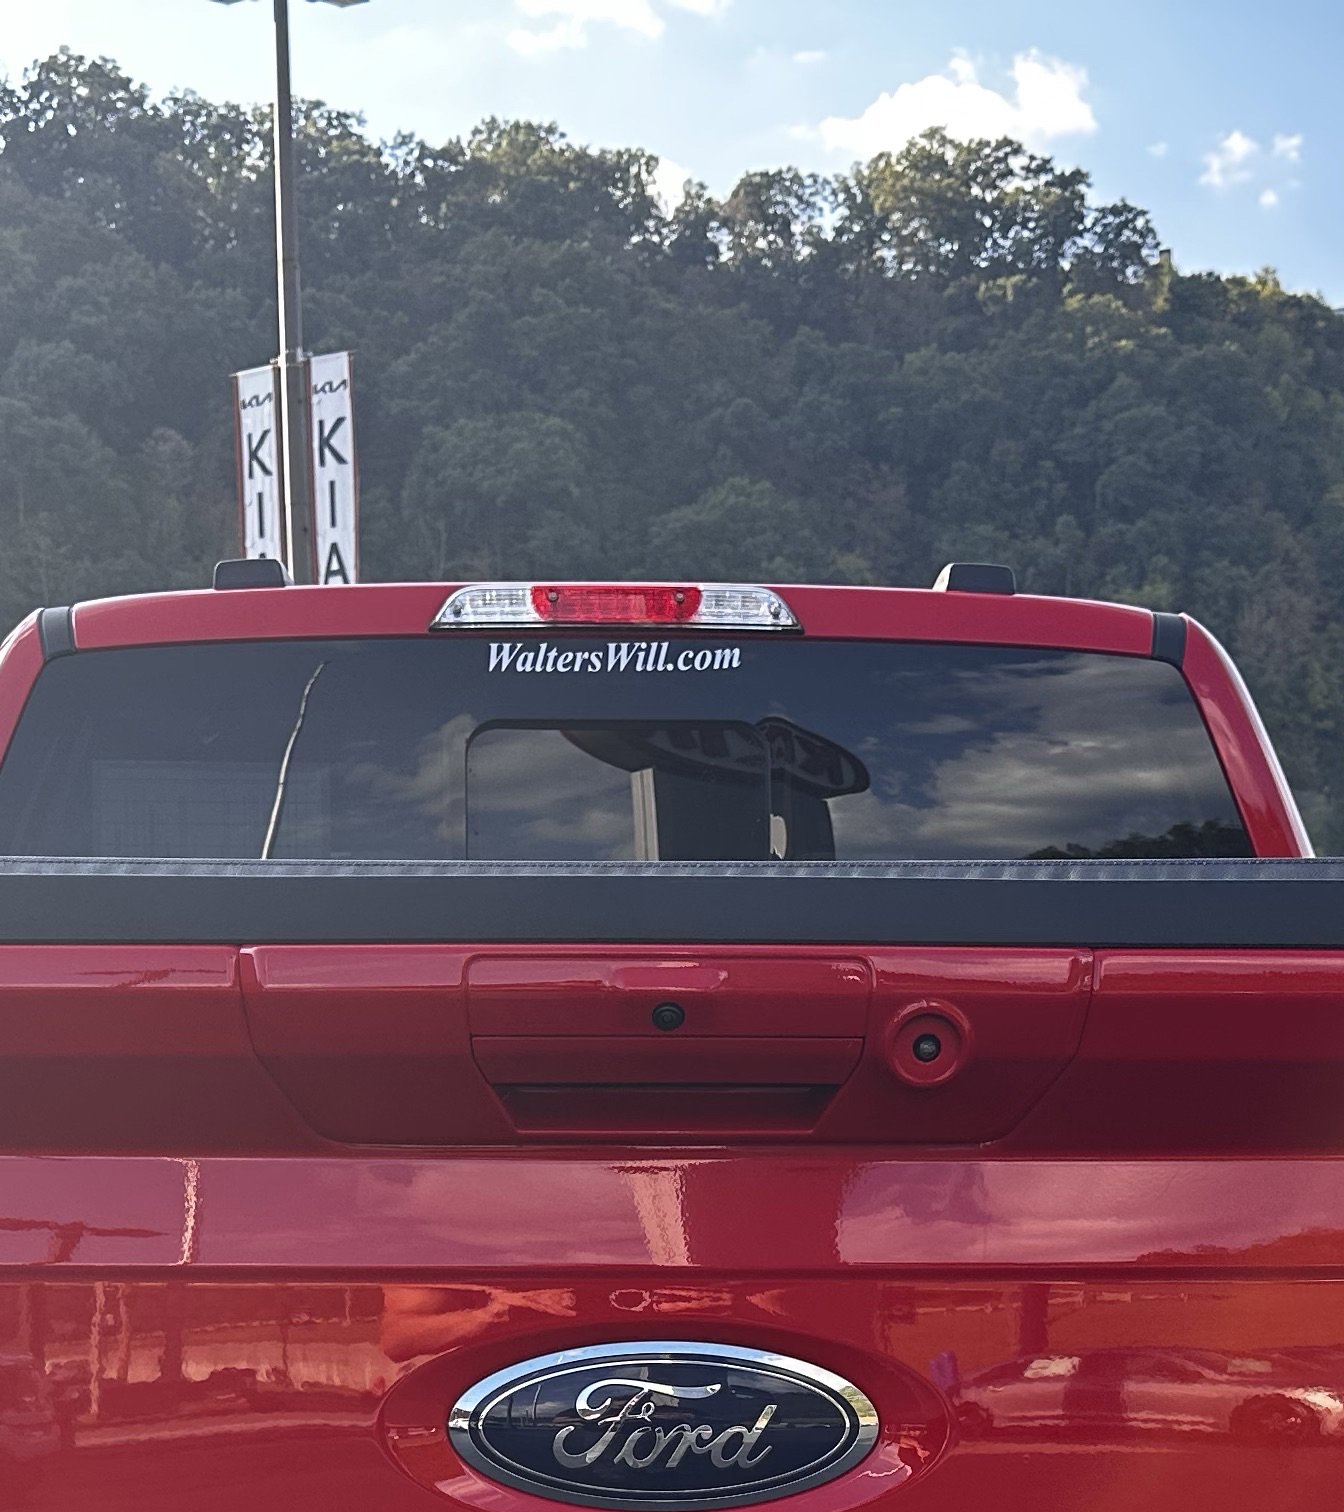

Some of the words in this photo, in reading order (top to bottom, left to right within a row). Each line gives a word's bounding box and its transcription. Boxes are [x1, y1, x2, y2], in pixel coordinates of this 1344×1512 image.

[246, 428, 273, 558] KI
[317, 416, 350, 584] KIA
[487, 642, 742, 673] WaltersWill.com
[552, 1378, 778, 1470] Ford
